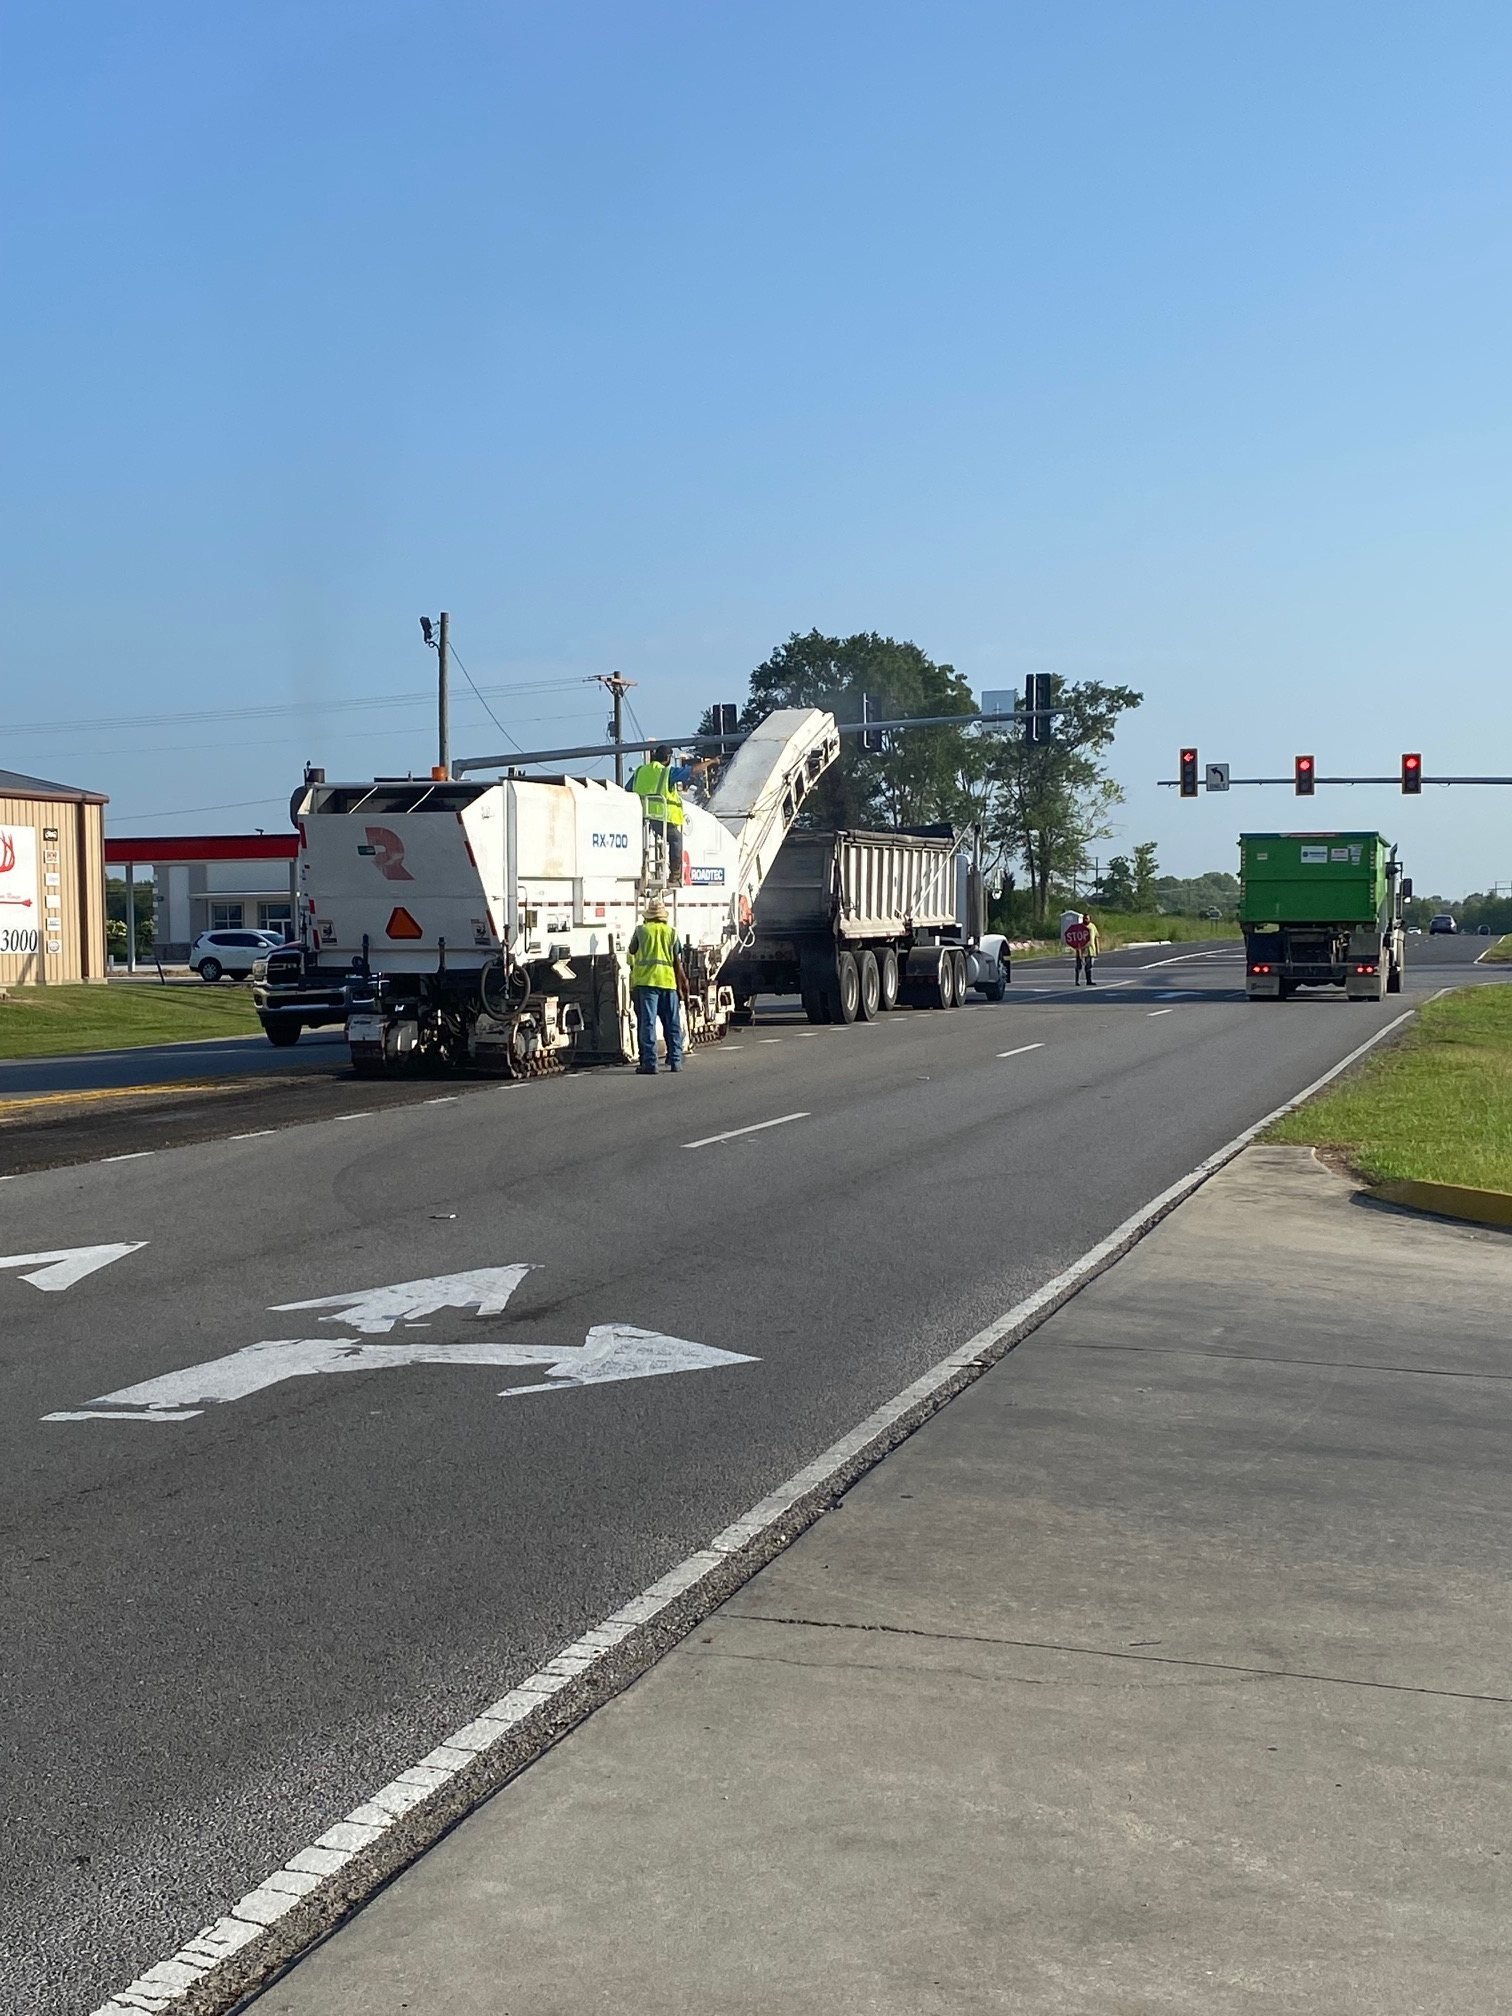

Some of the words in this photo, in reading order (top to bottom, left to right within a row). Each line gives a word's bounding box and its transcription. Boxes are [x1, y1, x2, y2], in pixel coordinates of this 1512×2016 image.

[592, 833, 628, 848] RX-700
[691, 868, 723, 881] ROADTEC
[0, 929, 37, 952] 3000
[1066, 931, 1089, 942] STOP
